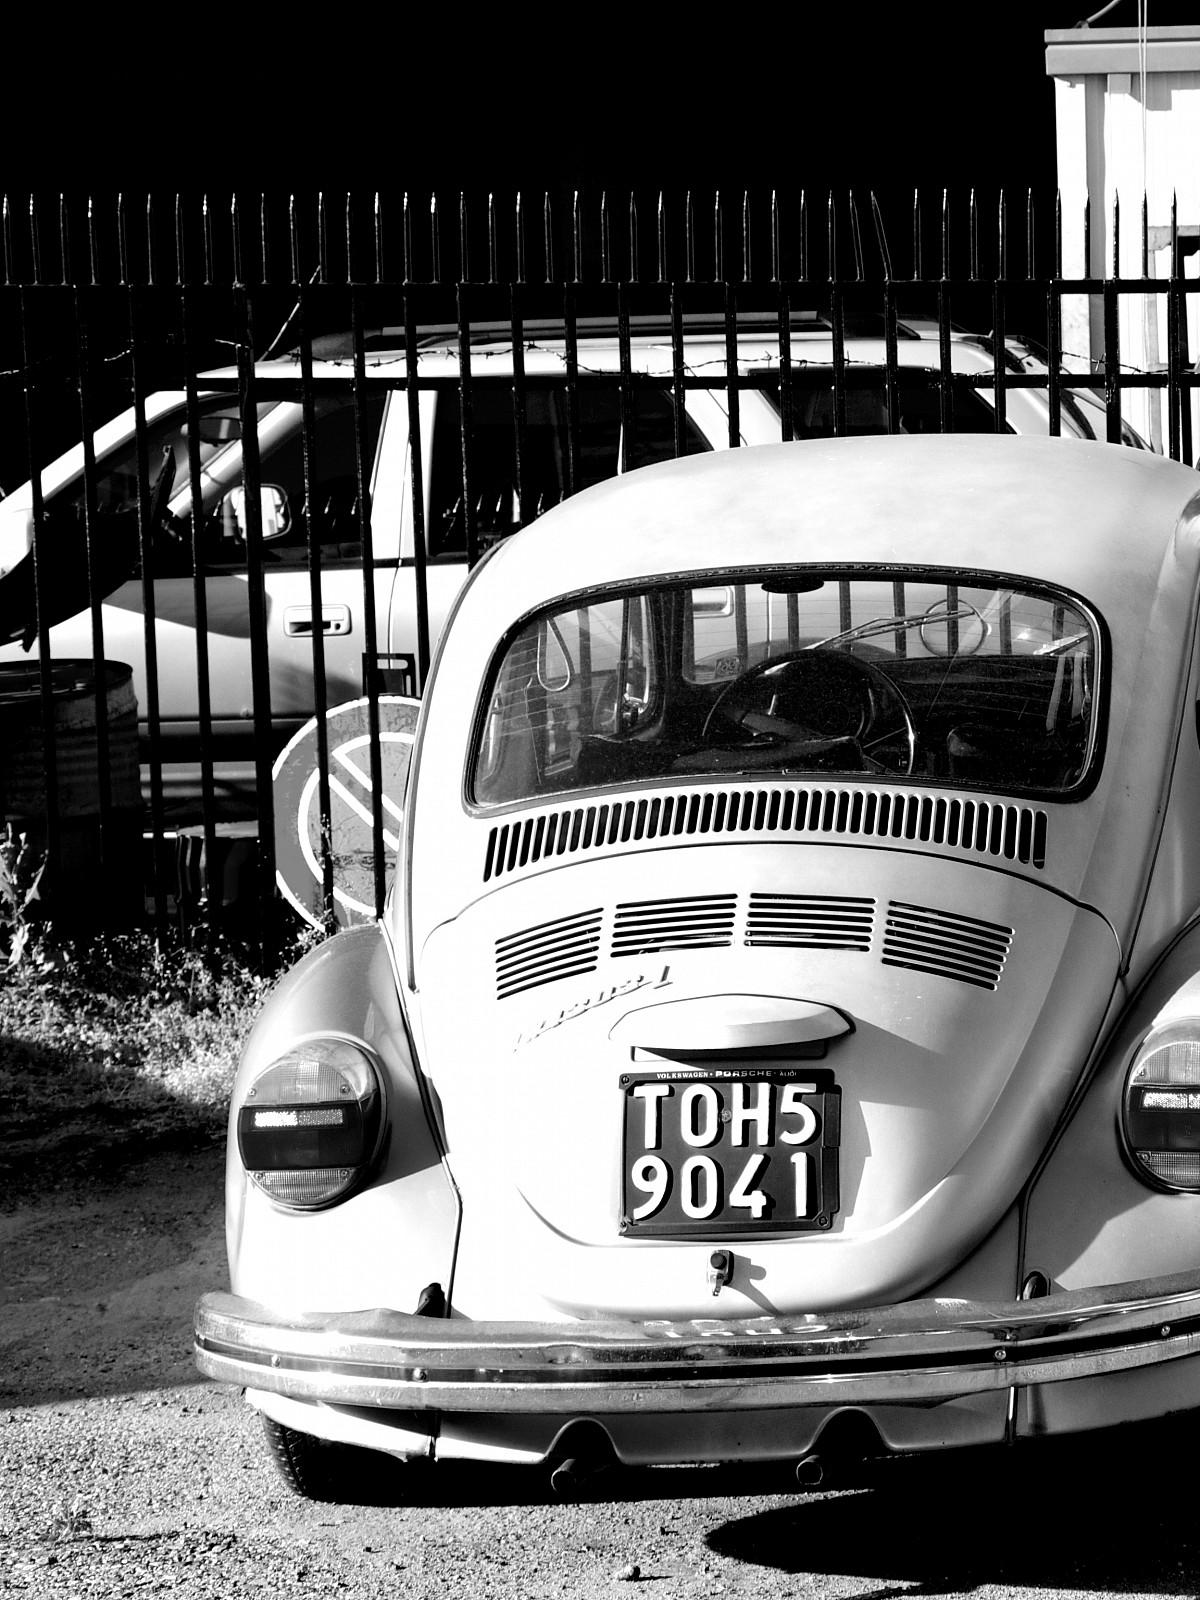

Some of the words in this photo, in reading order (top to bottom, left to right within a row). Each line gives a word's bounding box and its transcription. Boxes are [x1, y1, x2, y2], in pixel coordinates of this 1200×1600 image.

[656, 1071, 709, 1079] VOLKSWAGEN
[715, 1070, 772, 1078] PORSCHE
[633, 1082, 817, 1149] TOH5
[631, 1152, 808, 1220] 9041
